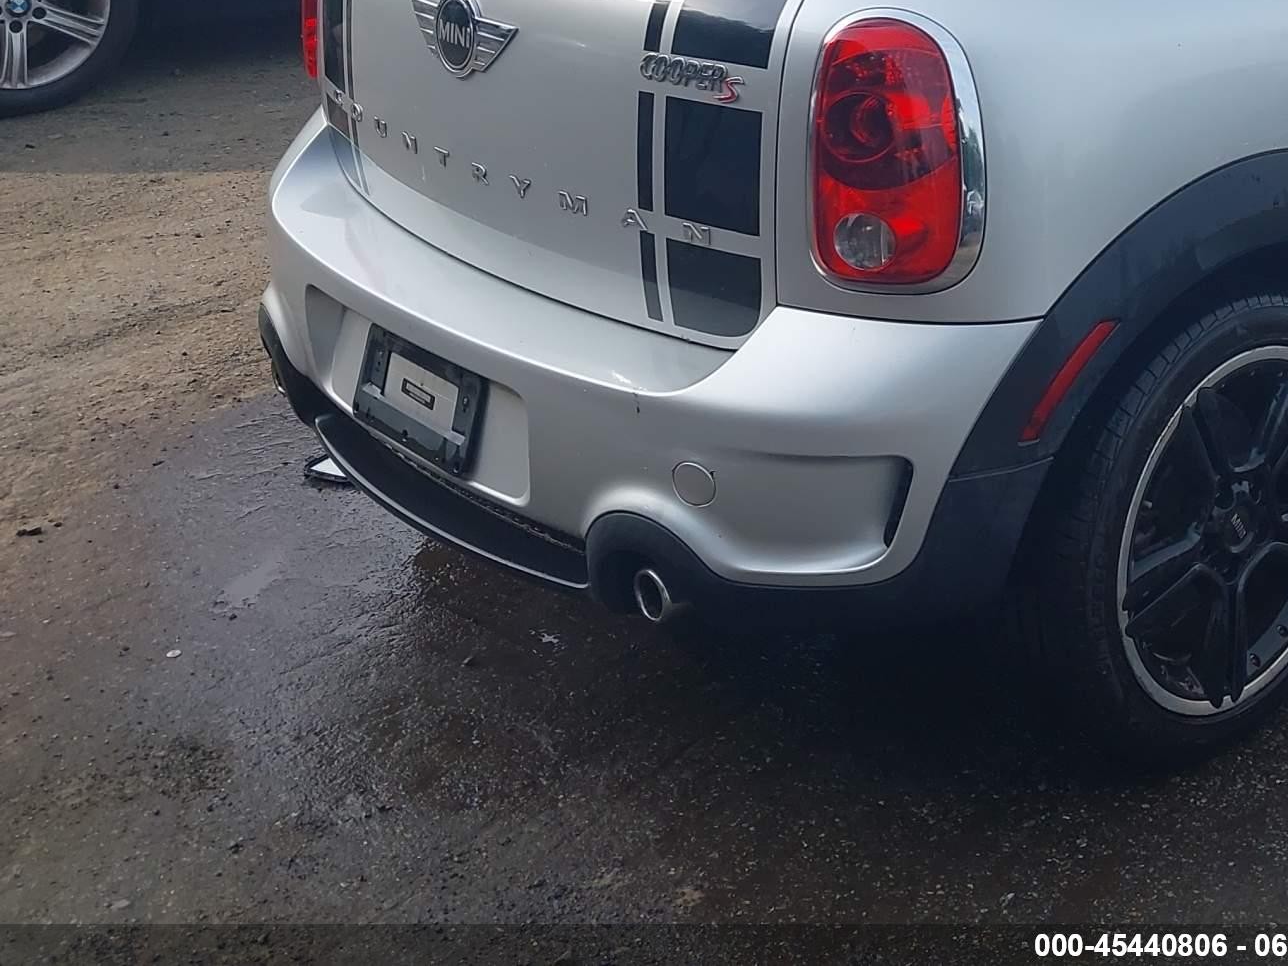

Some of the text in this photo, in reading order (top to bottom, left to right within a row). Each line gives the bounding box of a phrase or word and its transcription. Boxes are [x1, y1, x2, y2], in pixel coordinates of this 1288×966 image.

[640, 53, 745, 104] COOPER S
[333, 88, 712, 245] COUNTRYMAN
